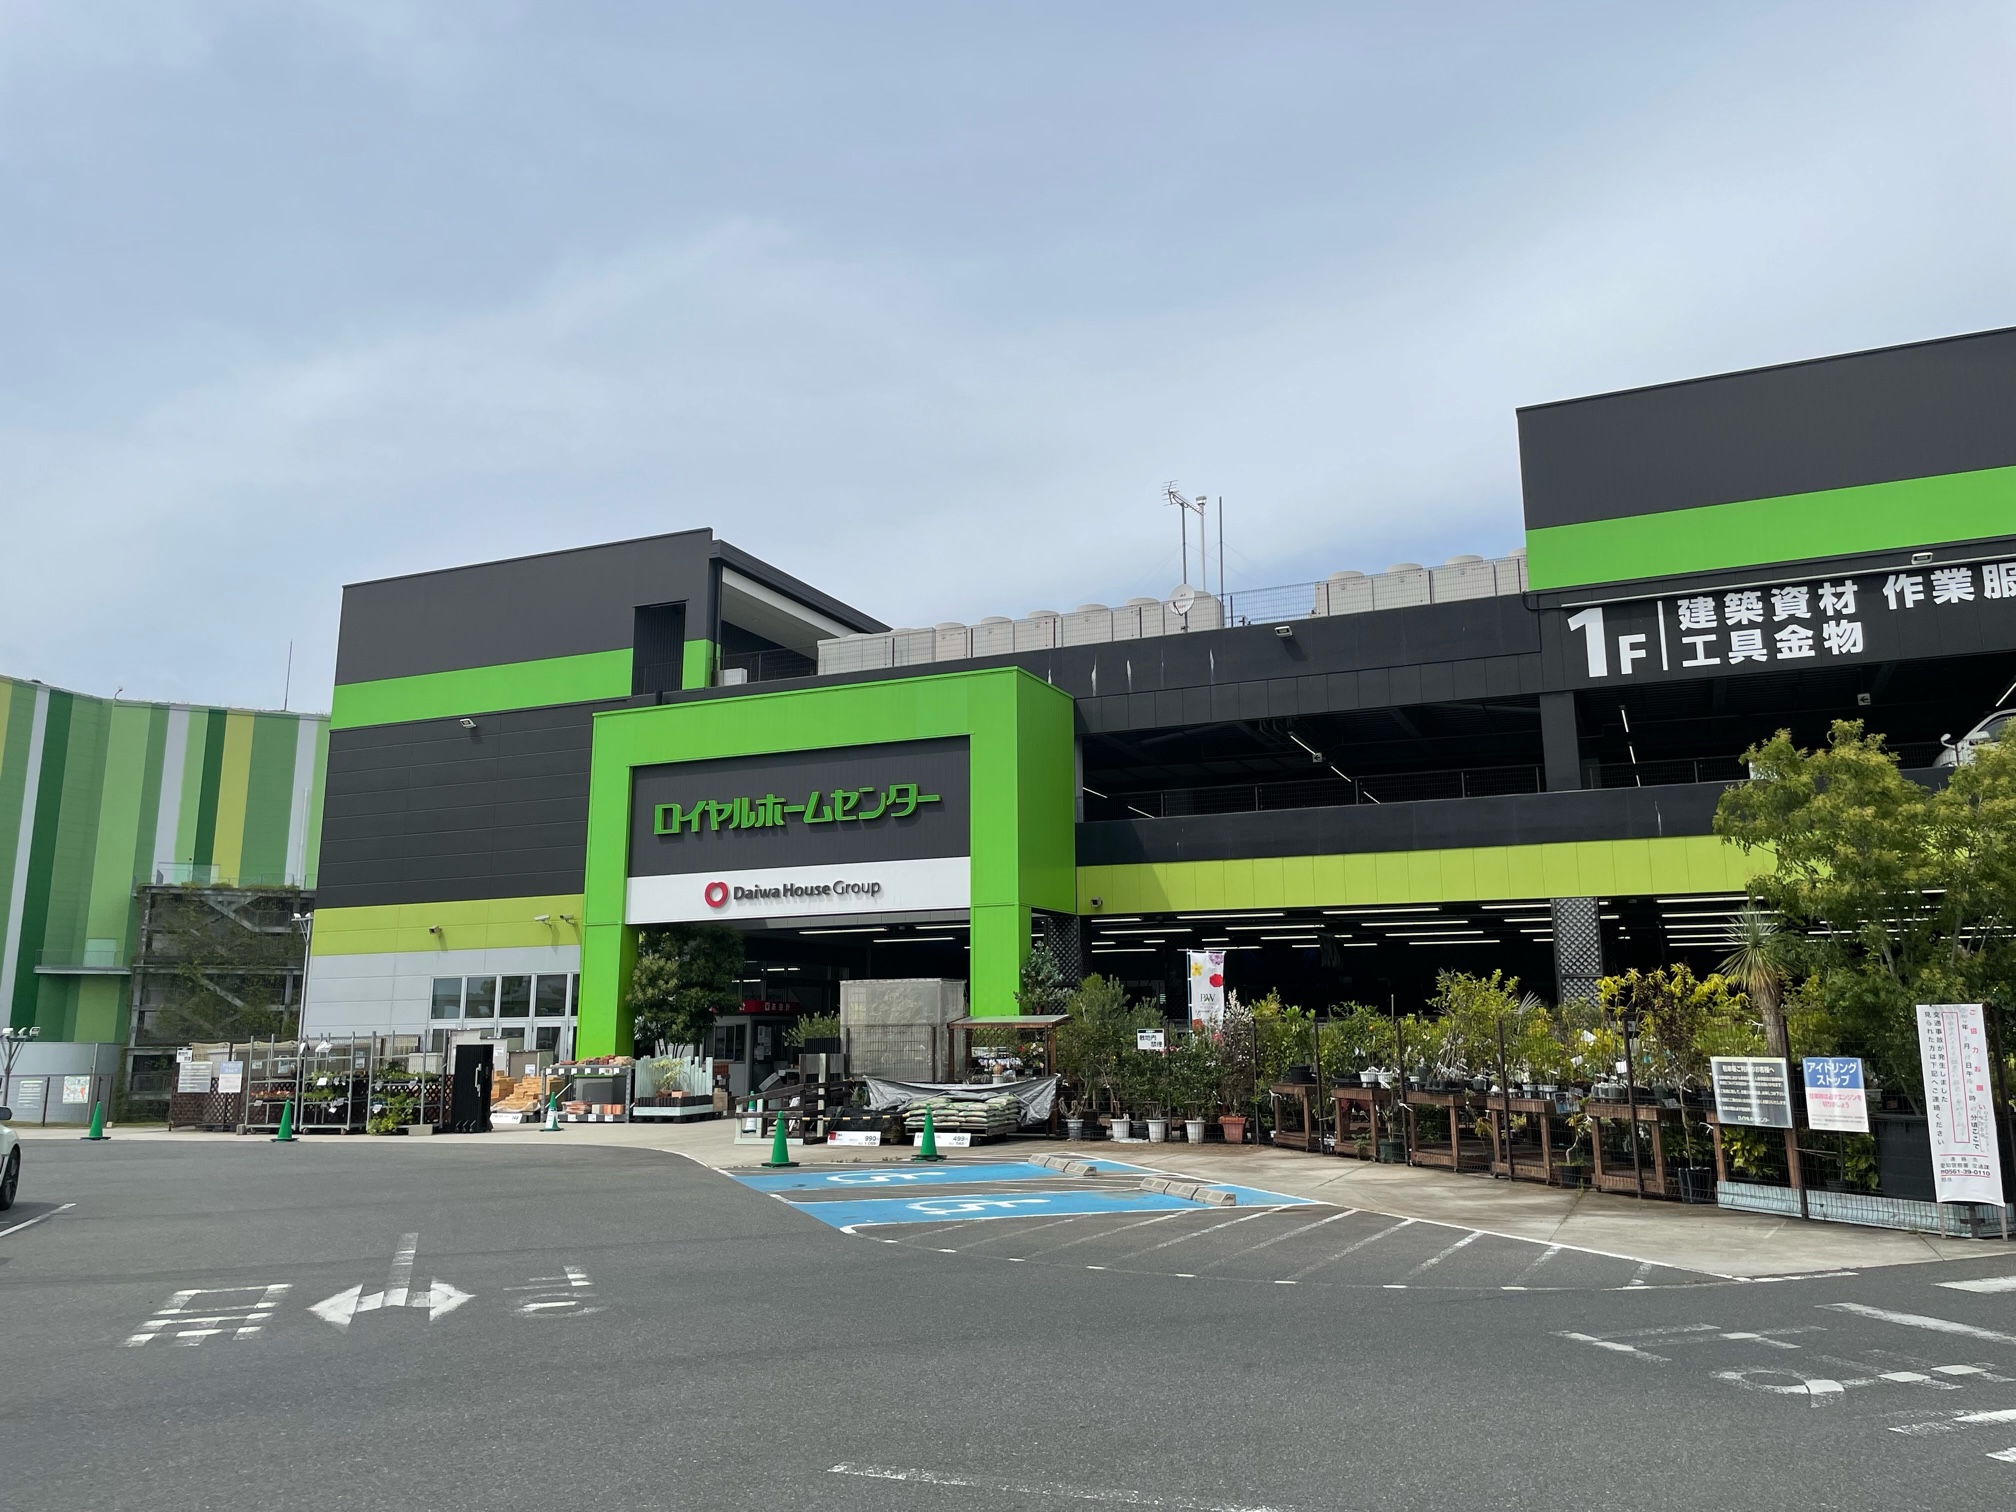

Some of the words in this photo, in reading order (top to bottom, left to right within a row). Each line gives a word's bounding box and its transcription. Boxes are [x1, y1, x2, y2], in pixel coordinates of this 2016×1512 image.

[1677, 580, 1859, 632] 建築資材
[1882, 562, 2016, 611] 作業服
[1567, 607, 1647, 677] 1F
[1681, 619, 1864, 667] 工具金物
[653, 783, 942, 836] ロイヤルホームセンター
[733, 884, 780, 901] Daiwa
[782, 882, 831, 898] House
[832, 880, 882, 898] Group
[1807, 1062, 1857, 1074] アイドリング
[1816, 1075, 1850, 1086] ストップ
